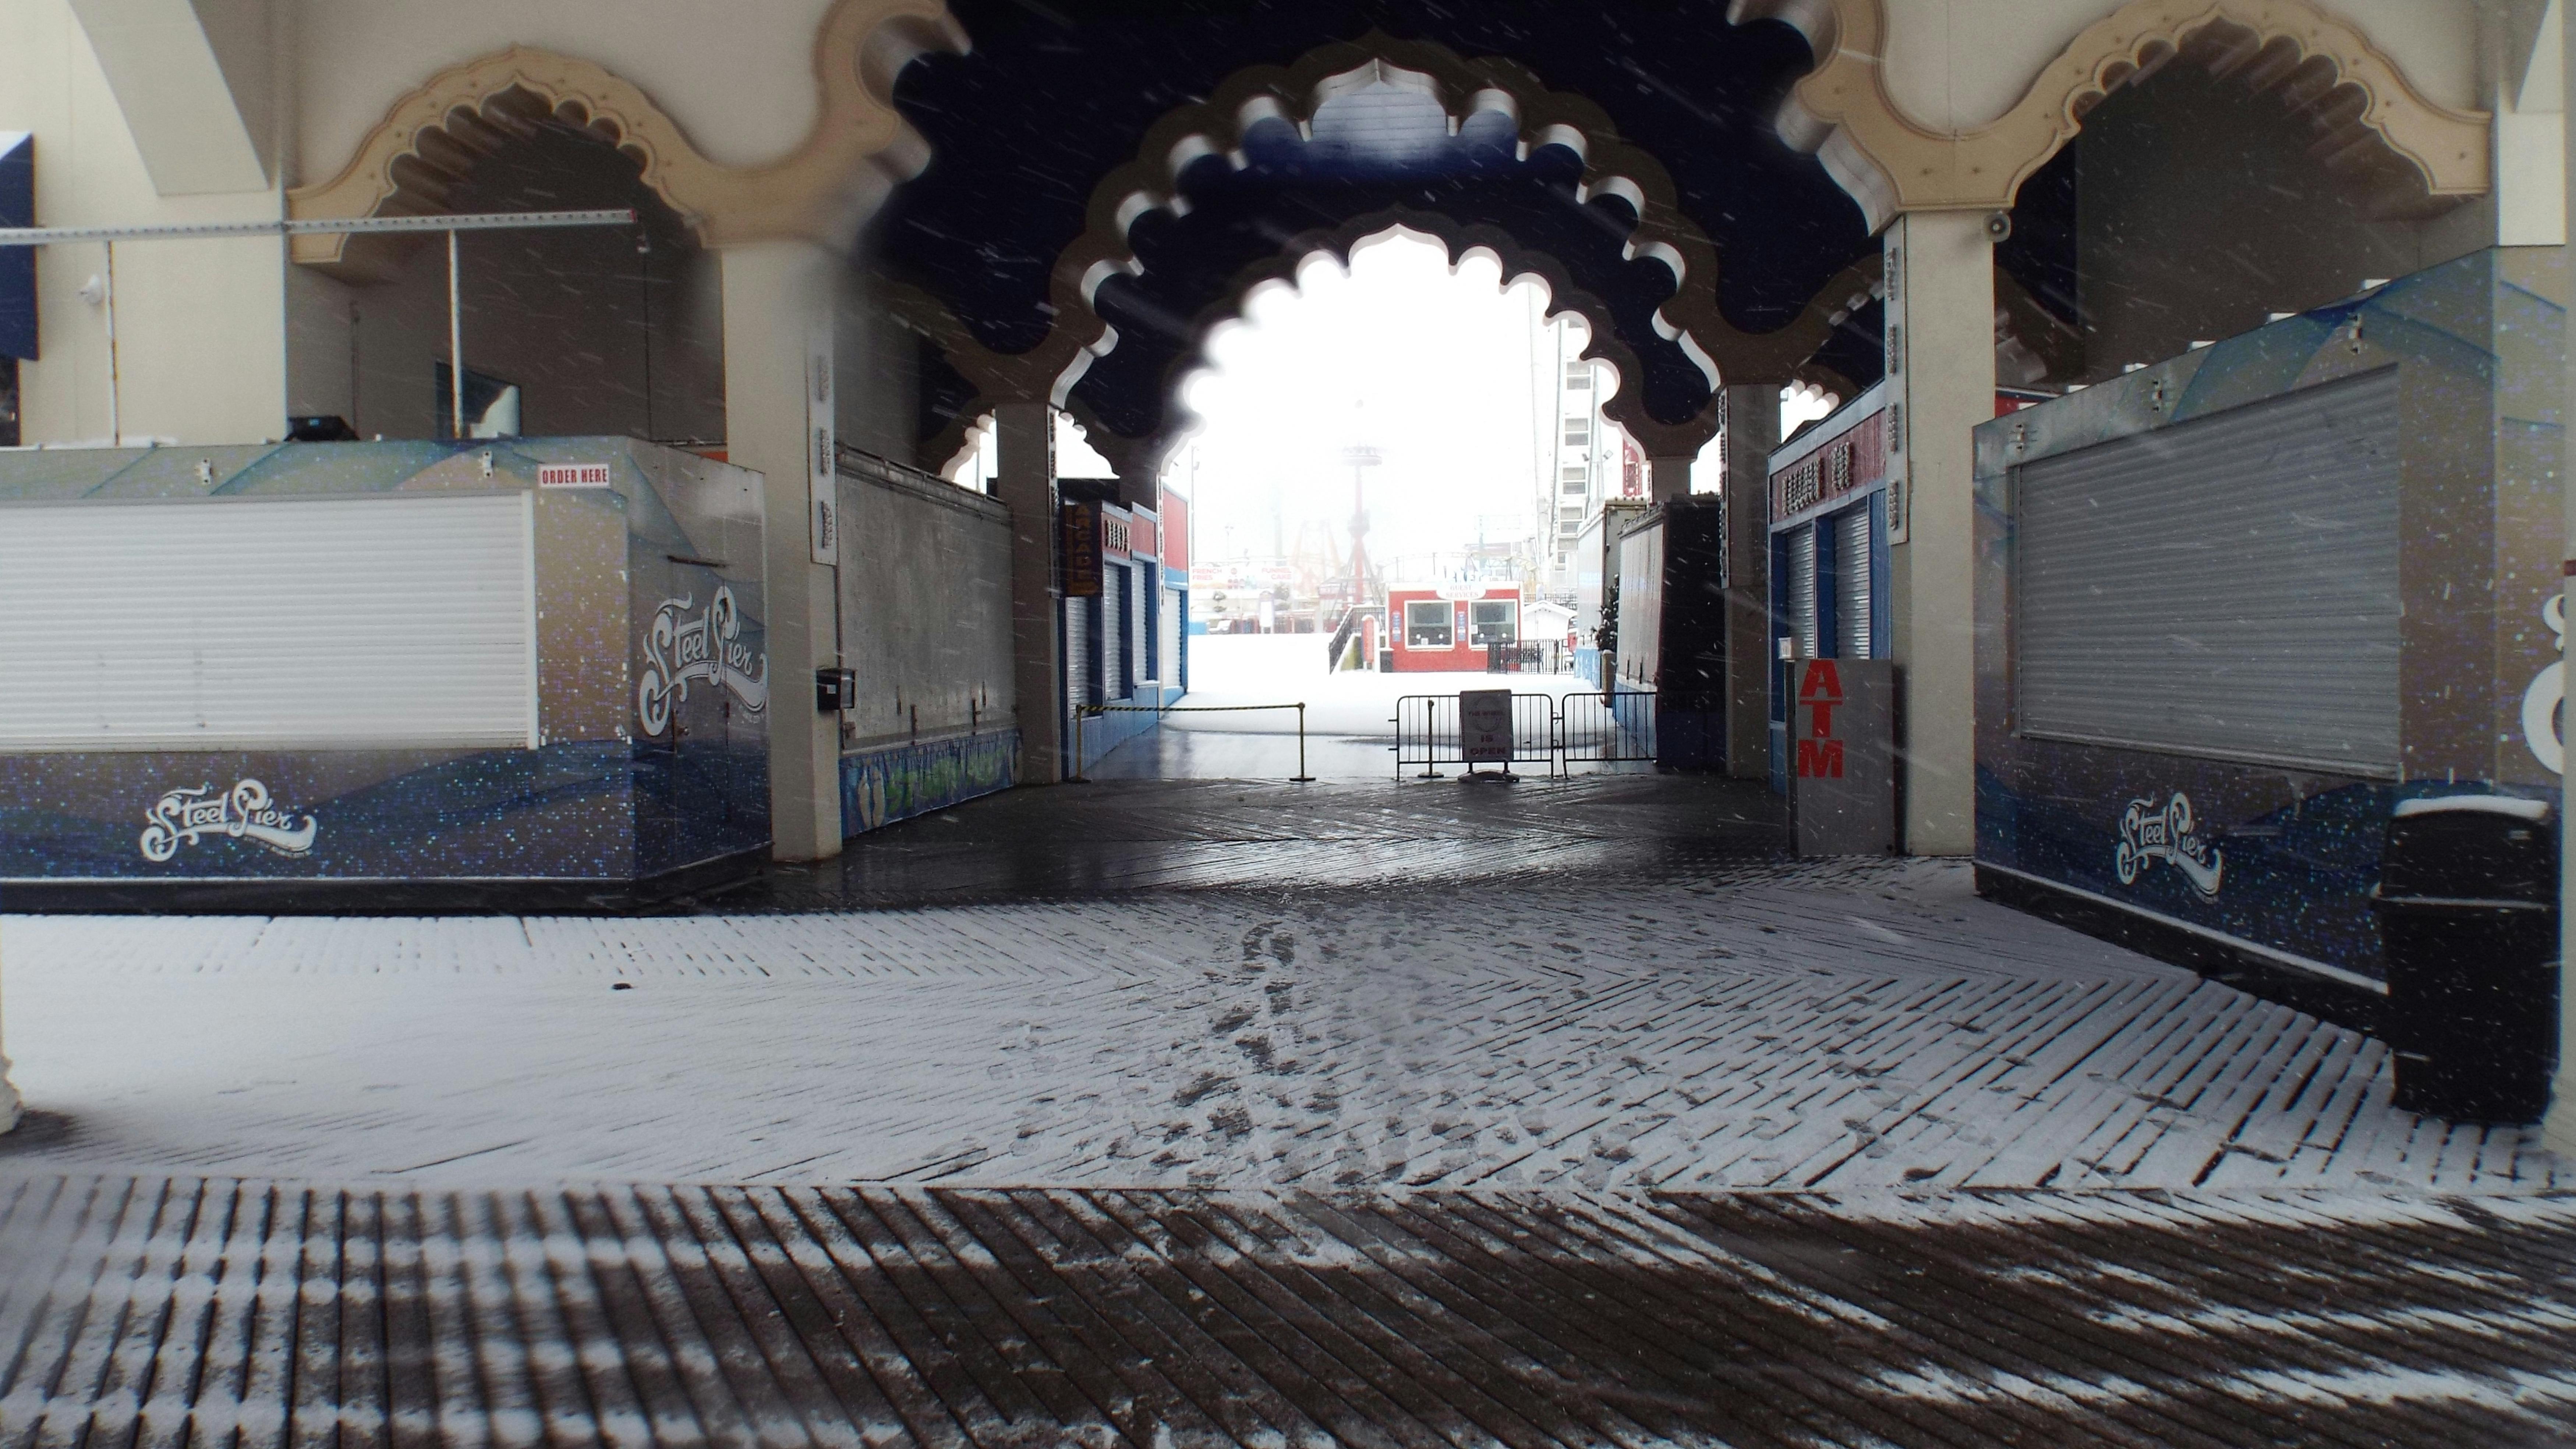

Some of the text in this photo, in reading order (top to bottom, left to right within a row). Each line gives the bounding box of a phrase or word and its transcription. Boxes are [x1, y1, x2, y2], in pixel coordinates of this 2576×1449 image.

[542, 469, 607, 483] ORDER HERE
[1075, 504, 1092, 580] ARCADE
[639, 585, 753, 736] Steel Pier
[1470, 747, 1505, 755] OPEN
[1798, 659, 1844, 779] ATM
[140, 778, 294, 862] Steel Pier
[2117, 792, 2207, 885] Steel Pier
